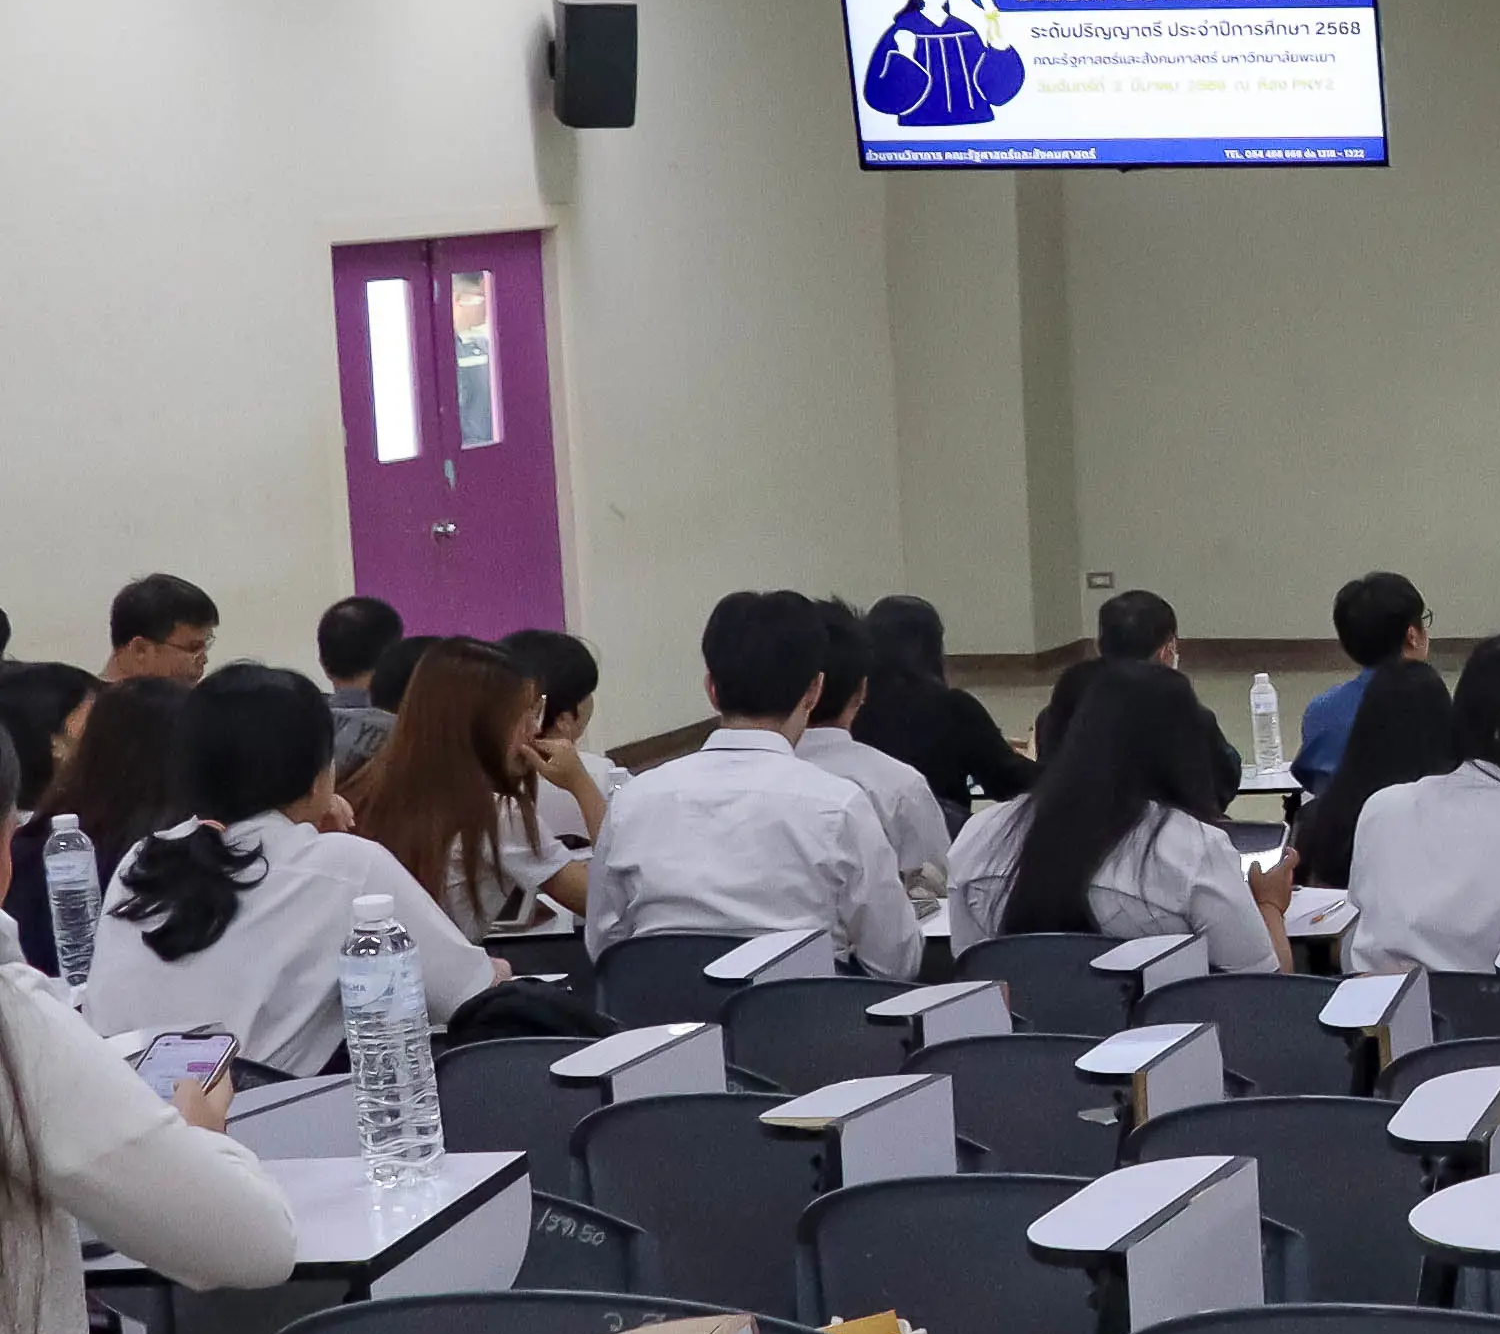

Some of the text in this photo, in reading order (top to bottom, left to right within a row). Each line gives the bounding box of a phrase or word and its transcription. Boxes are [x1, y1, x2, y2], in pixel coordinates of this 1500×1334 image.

[1031, 20, 1162, 40] ระดับปริญญาตรี
[1315, 21, 1361, 35] 2568
